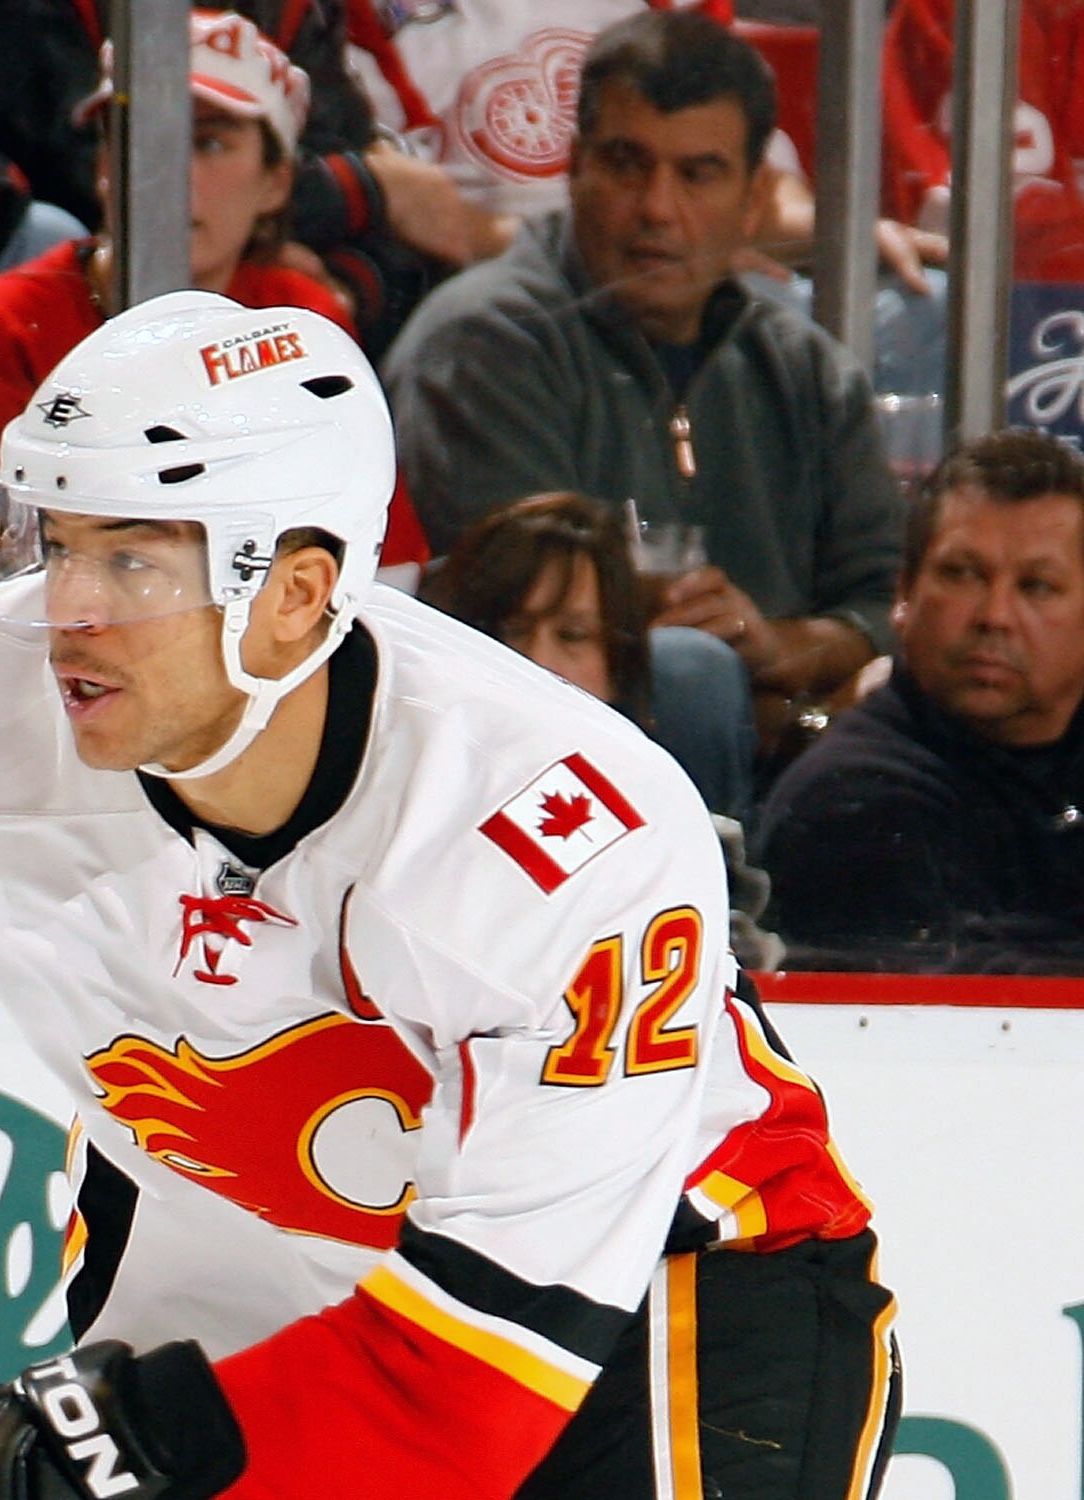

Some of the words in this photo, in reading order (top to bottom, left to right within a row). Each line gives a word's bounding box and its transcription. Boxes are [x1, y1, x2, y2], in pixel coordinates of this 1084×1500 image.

[199, 332, 306, 386] FLAMES
[222, 322, 290, 348] CALGARY
[539, 903, 704, 1087] 12
